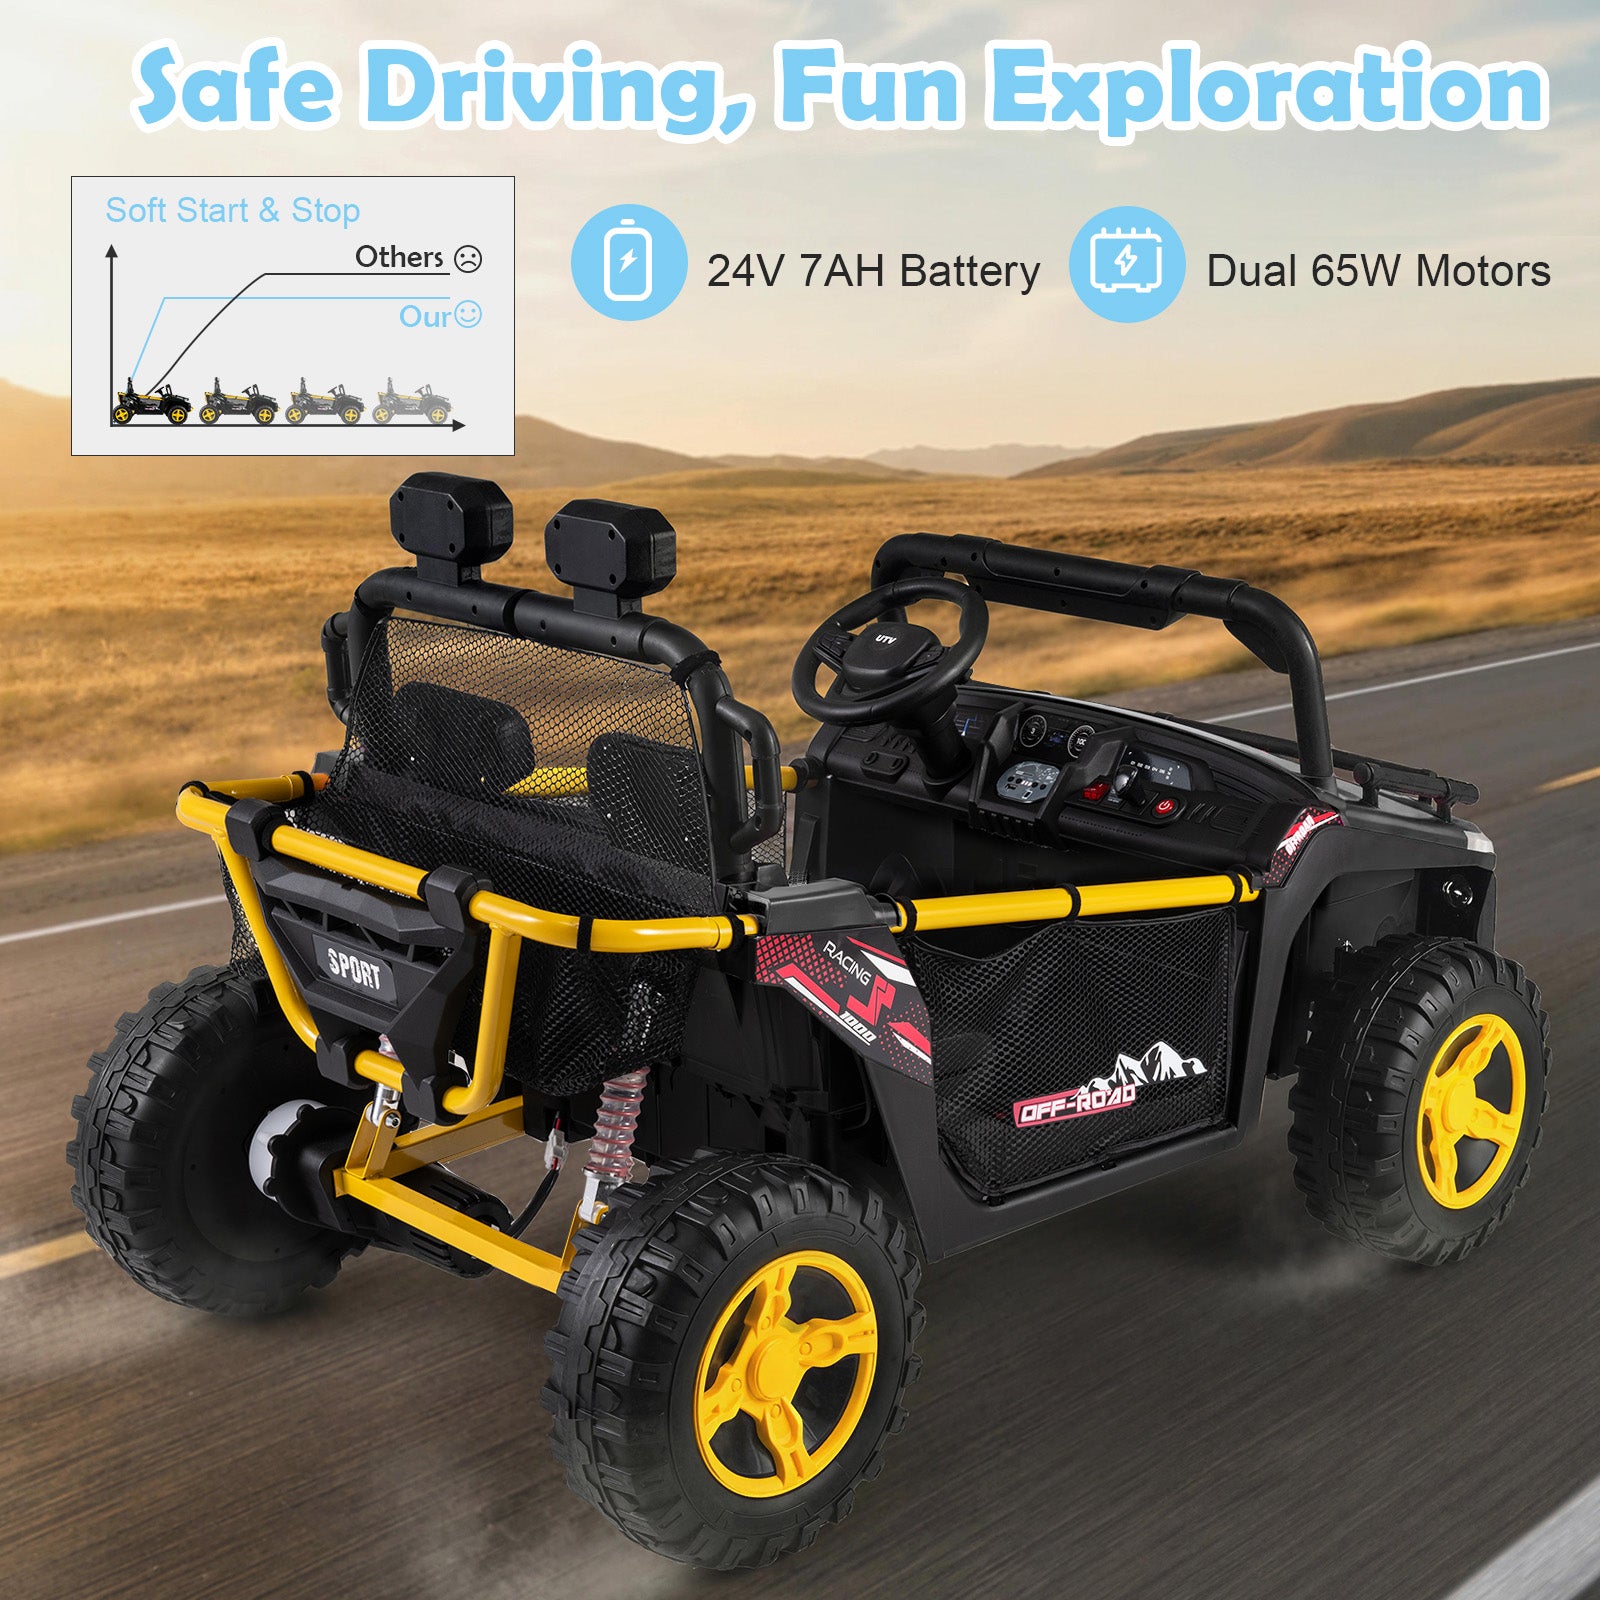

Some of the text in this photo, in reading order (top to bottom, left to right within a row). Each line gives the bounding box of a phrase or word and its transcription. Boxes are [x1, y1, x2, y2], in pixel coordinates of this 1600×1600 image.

[875, 634, 898, 645] UTV
[327, 947, 381, 991] SPORT
[822, 940, 872, 987] RACING
[838, 1010, 878, 1044] 1000
[1020, 1082, 1137, 1123] OFF-ROAD
